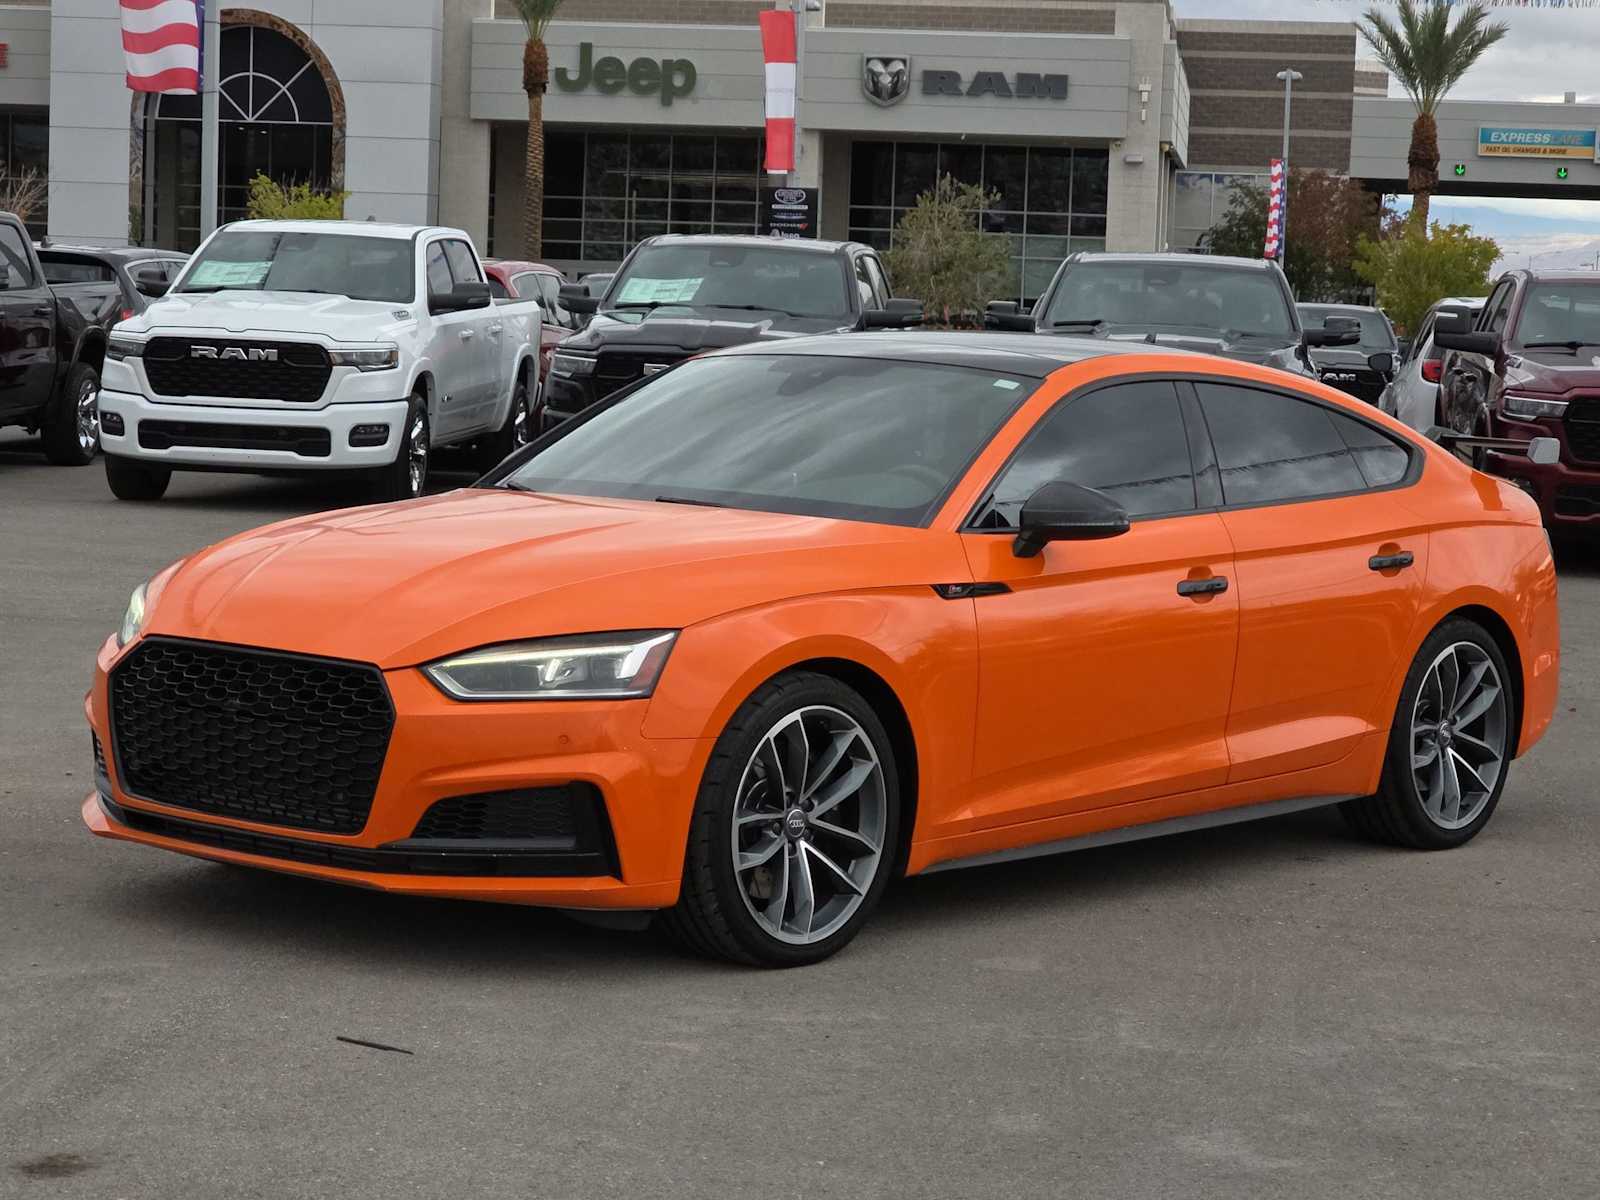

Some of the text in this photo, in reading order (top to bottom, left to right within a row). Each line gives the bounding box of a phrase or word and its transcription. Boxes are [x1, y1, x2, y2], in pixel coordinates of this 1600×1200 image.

[555, 42, 697, 107] Jeep
[922, 69, 1069, 100] RAM
[1490, 131, 1552, 143] EXPRESS
[190, 345, 279, 361] RAM
